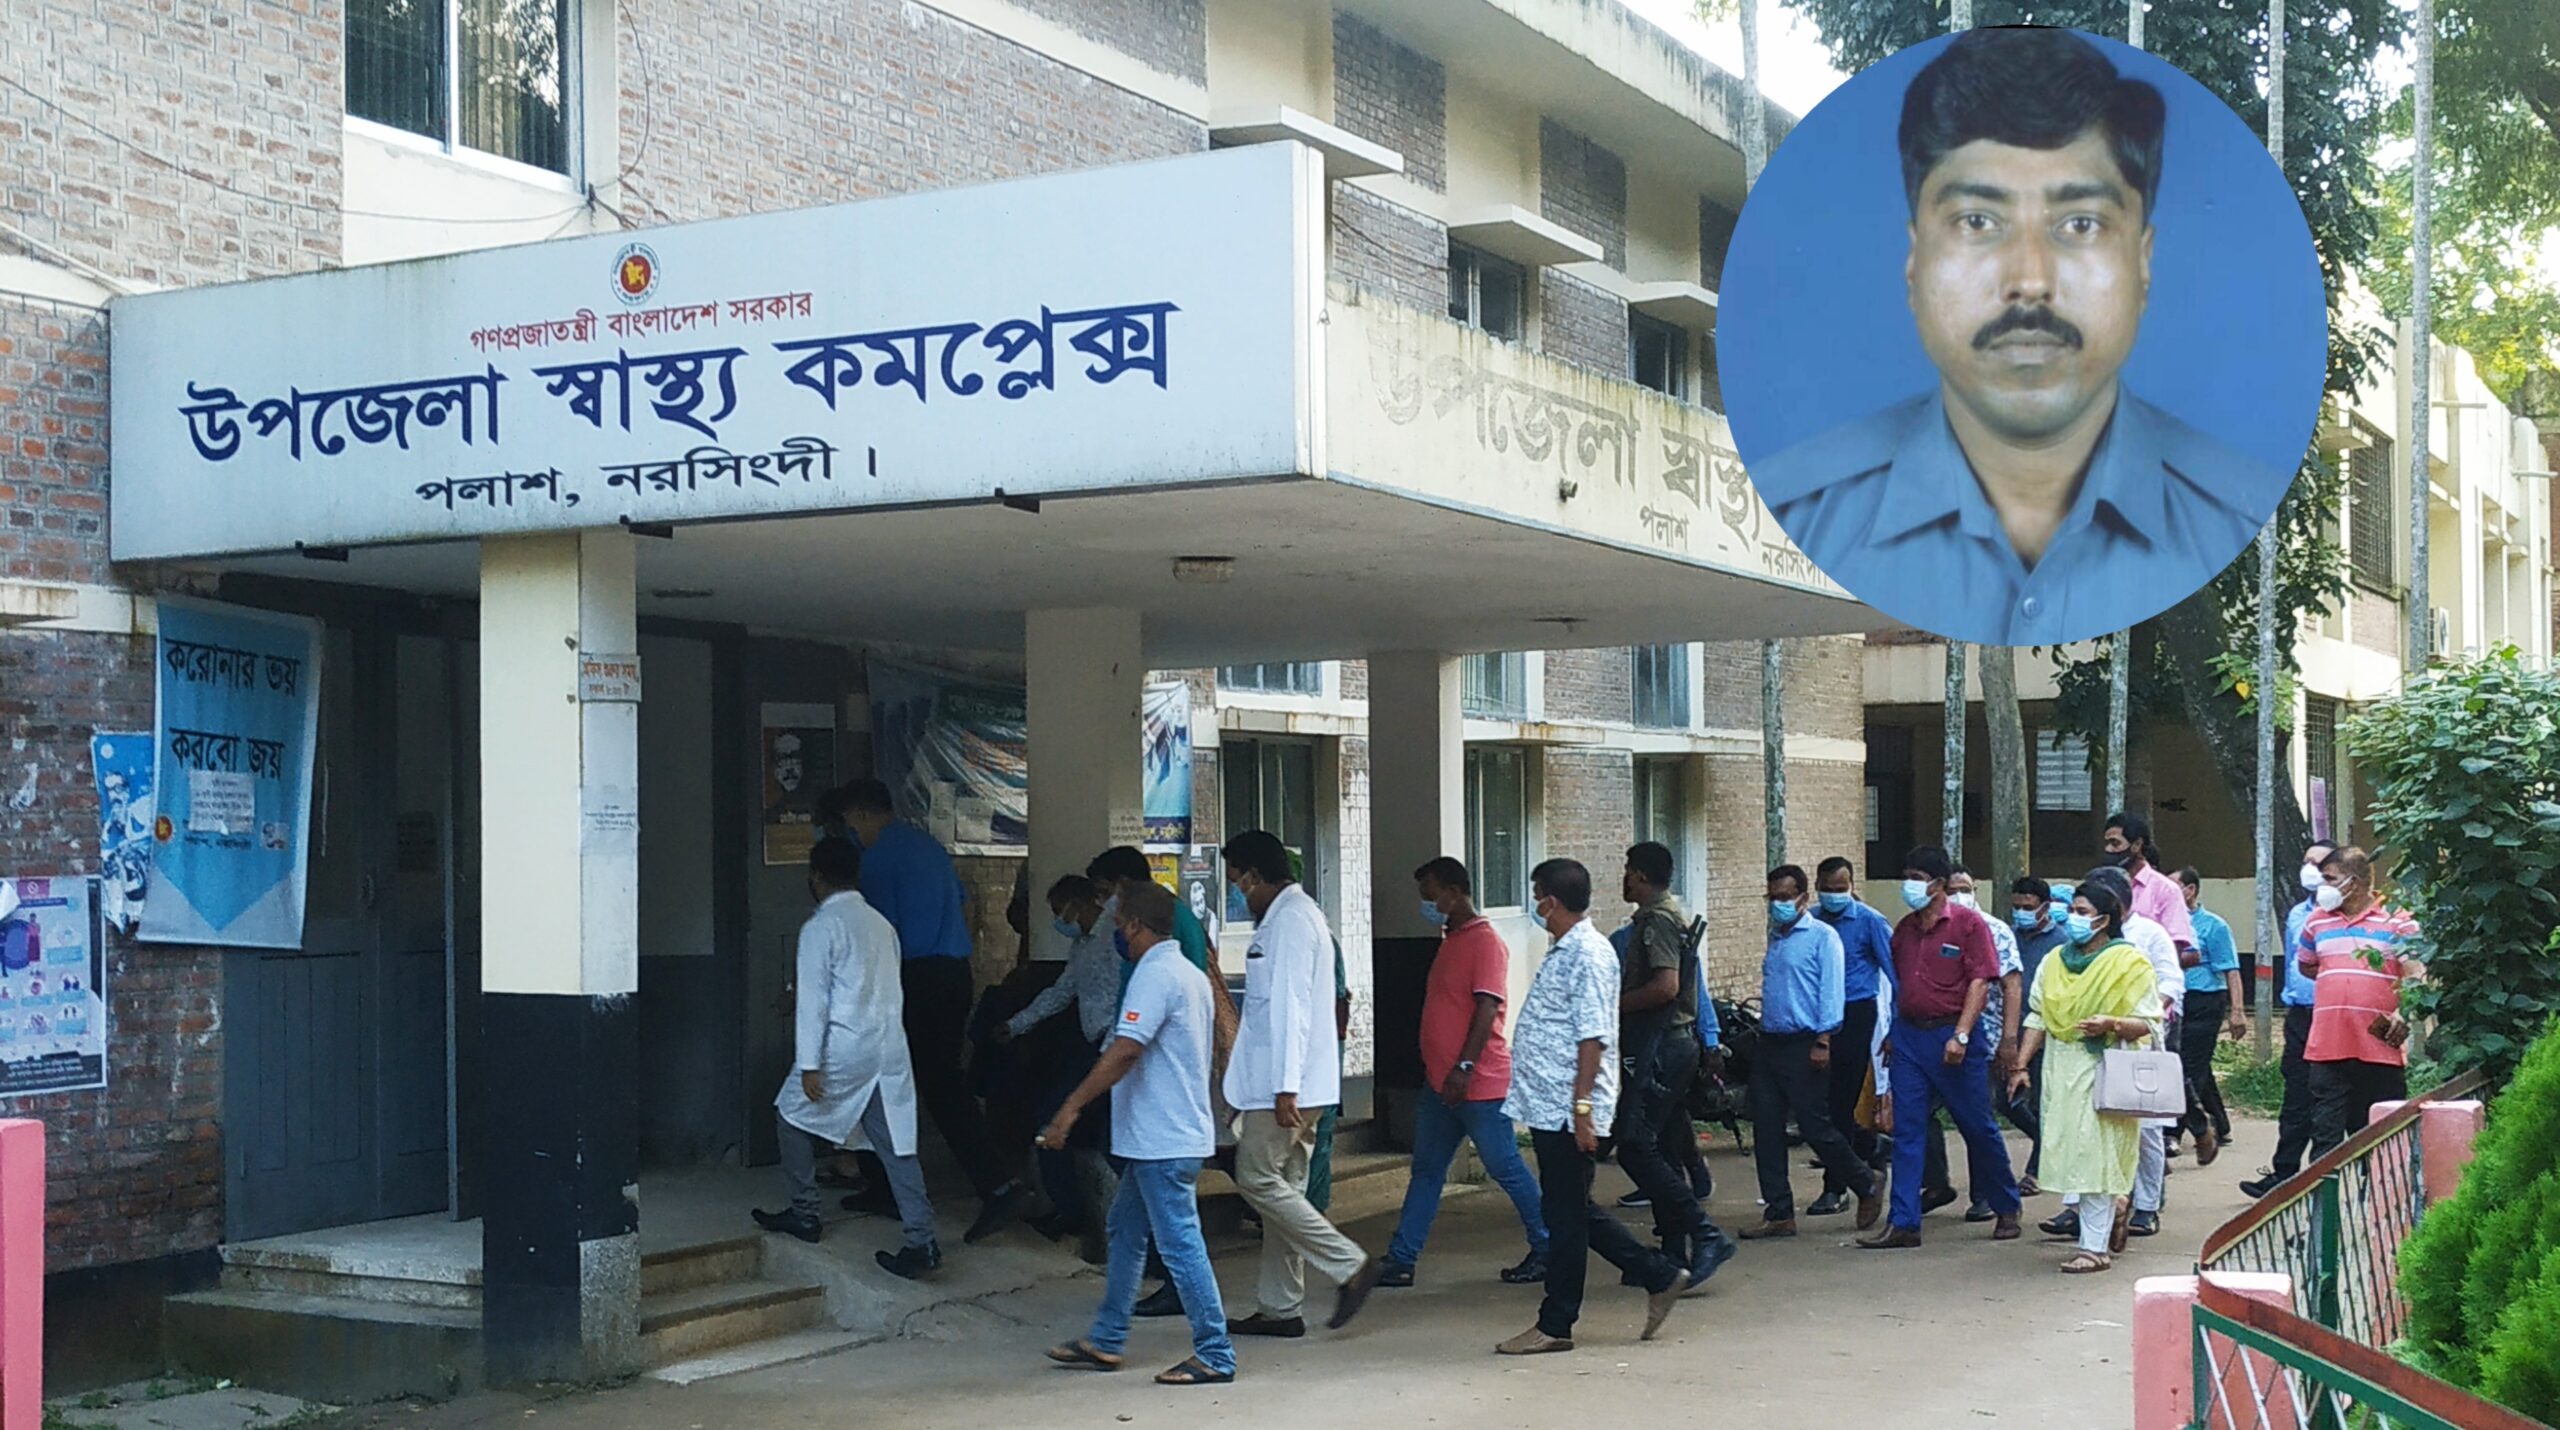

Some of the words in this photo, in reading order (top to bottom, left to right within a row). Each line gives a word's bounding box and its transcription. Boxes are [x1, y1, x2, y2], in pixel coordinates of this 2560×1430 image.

[470, 307, 597, 354] গণপ্রজাতন্ত্রী
[608, 299, 719, 338] বাংলাদেশ
[729, 291, 813, 324] সরকার
[179, 362, 507, 462] উপজেলা
[530, 344, 749, 442] স্বাস্থ্য
[772, 301, 1182, 410] কমপ্লেক্স
[1364, 322, 1641, 490] উপজেলা
[599, 437, 838, 492] নরসিংদী
[1640, 503, 1690, 552] পলাশ
[165, 637, 258, 691] করোনার
[265, 654, 302, 697] ভয়
[169, 727, 241, 774] করবো
[247, 739, 286, 779] জয়
